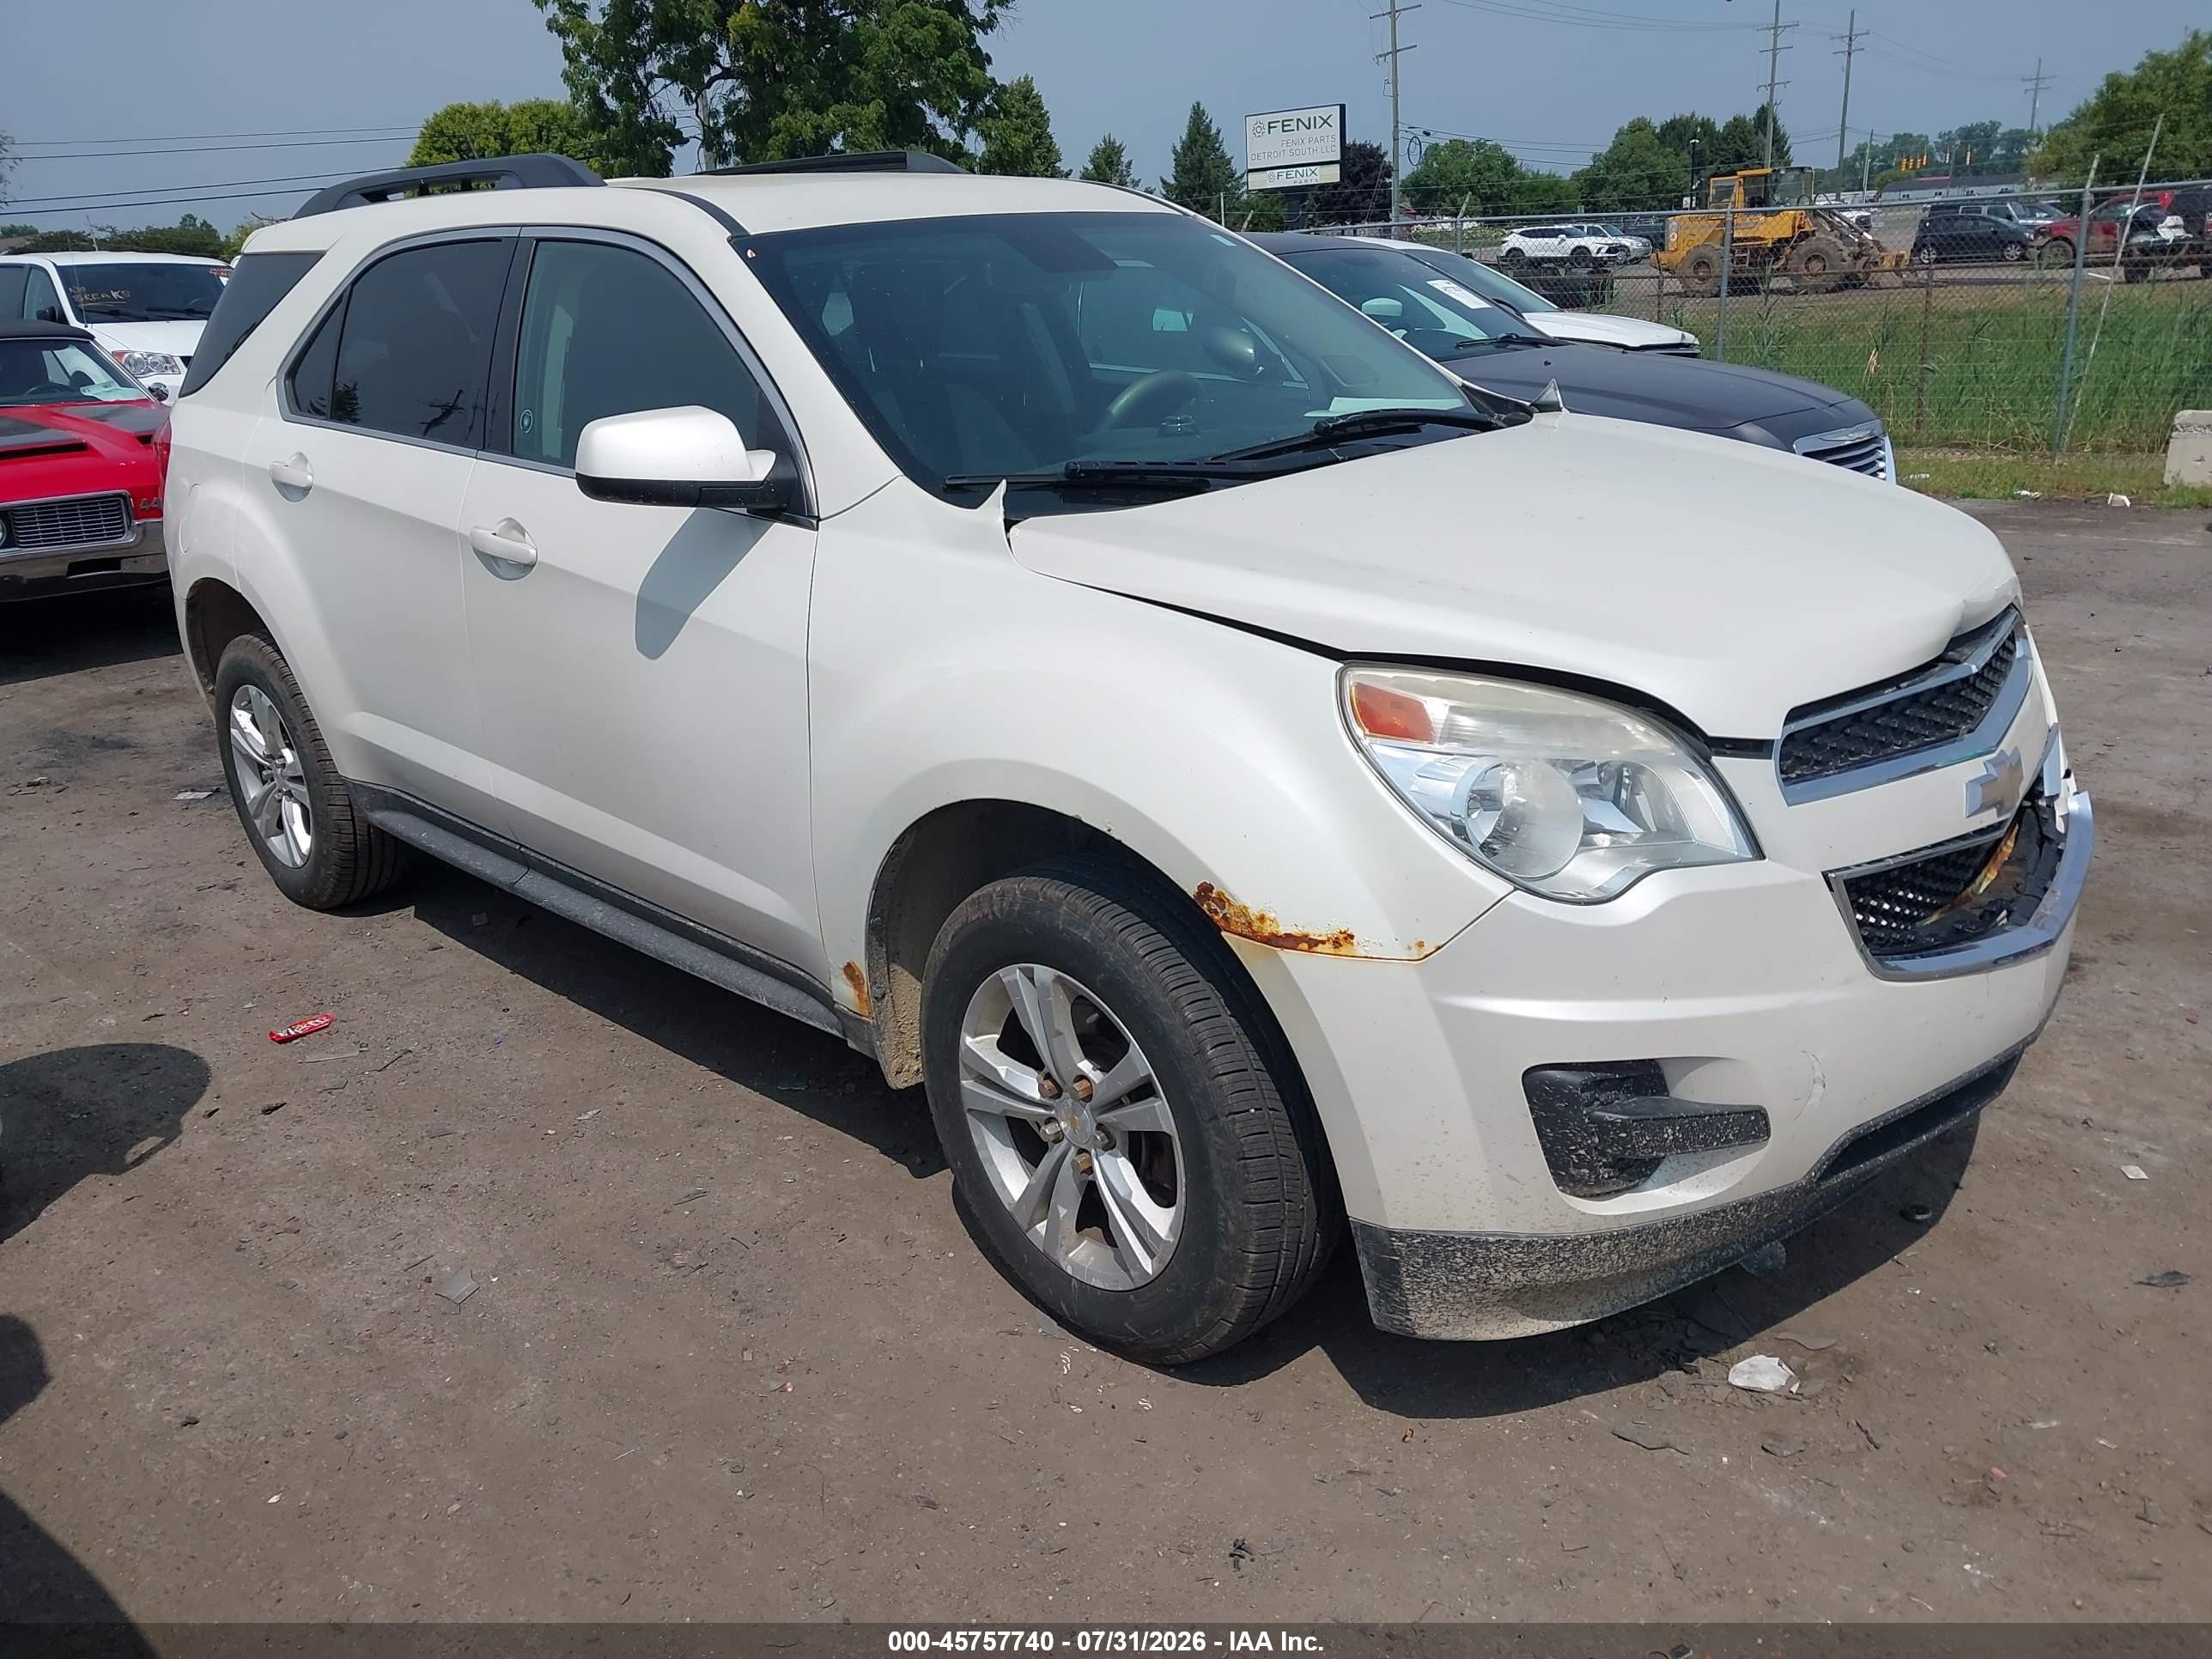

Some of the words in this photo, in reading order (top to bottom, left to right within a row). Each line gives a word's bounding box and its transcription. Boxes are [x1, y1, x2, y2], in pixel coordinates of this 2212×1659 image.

[1267, 113, 1334, 135] FENIX
[1281, 138, 1306, 148] FENIX
[1309, 135, 1336, 144] PARTS
[1251, 149, 1286, 161] DETROIT
[1289, 146, 1318, 157] SOUTH
[1321, 144, 1336, 154] LLC
[1277, 167, 1318, 180] FENIX
